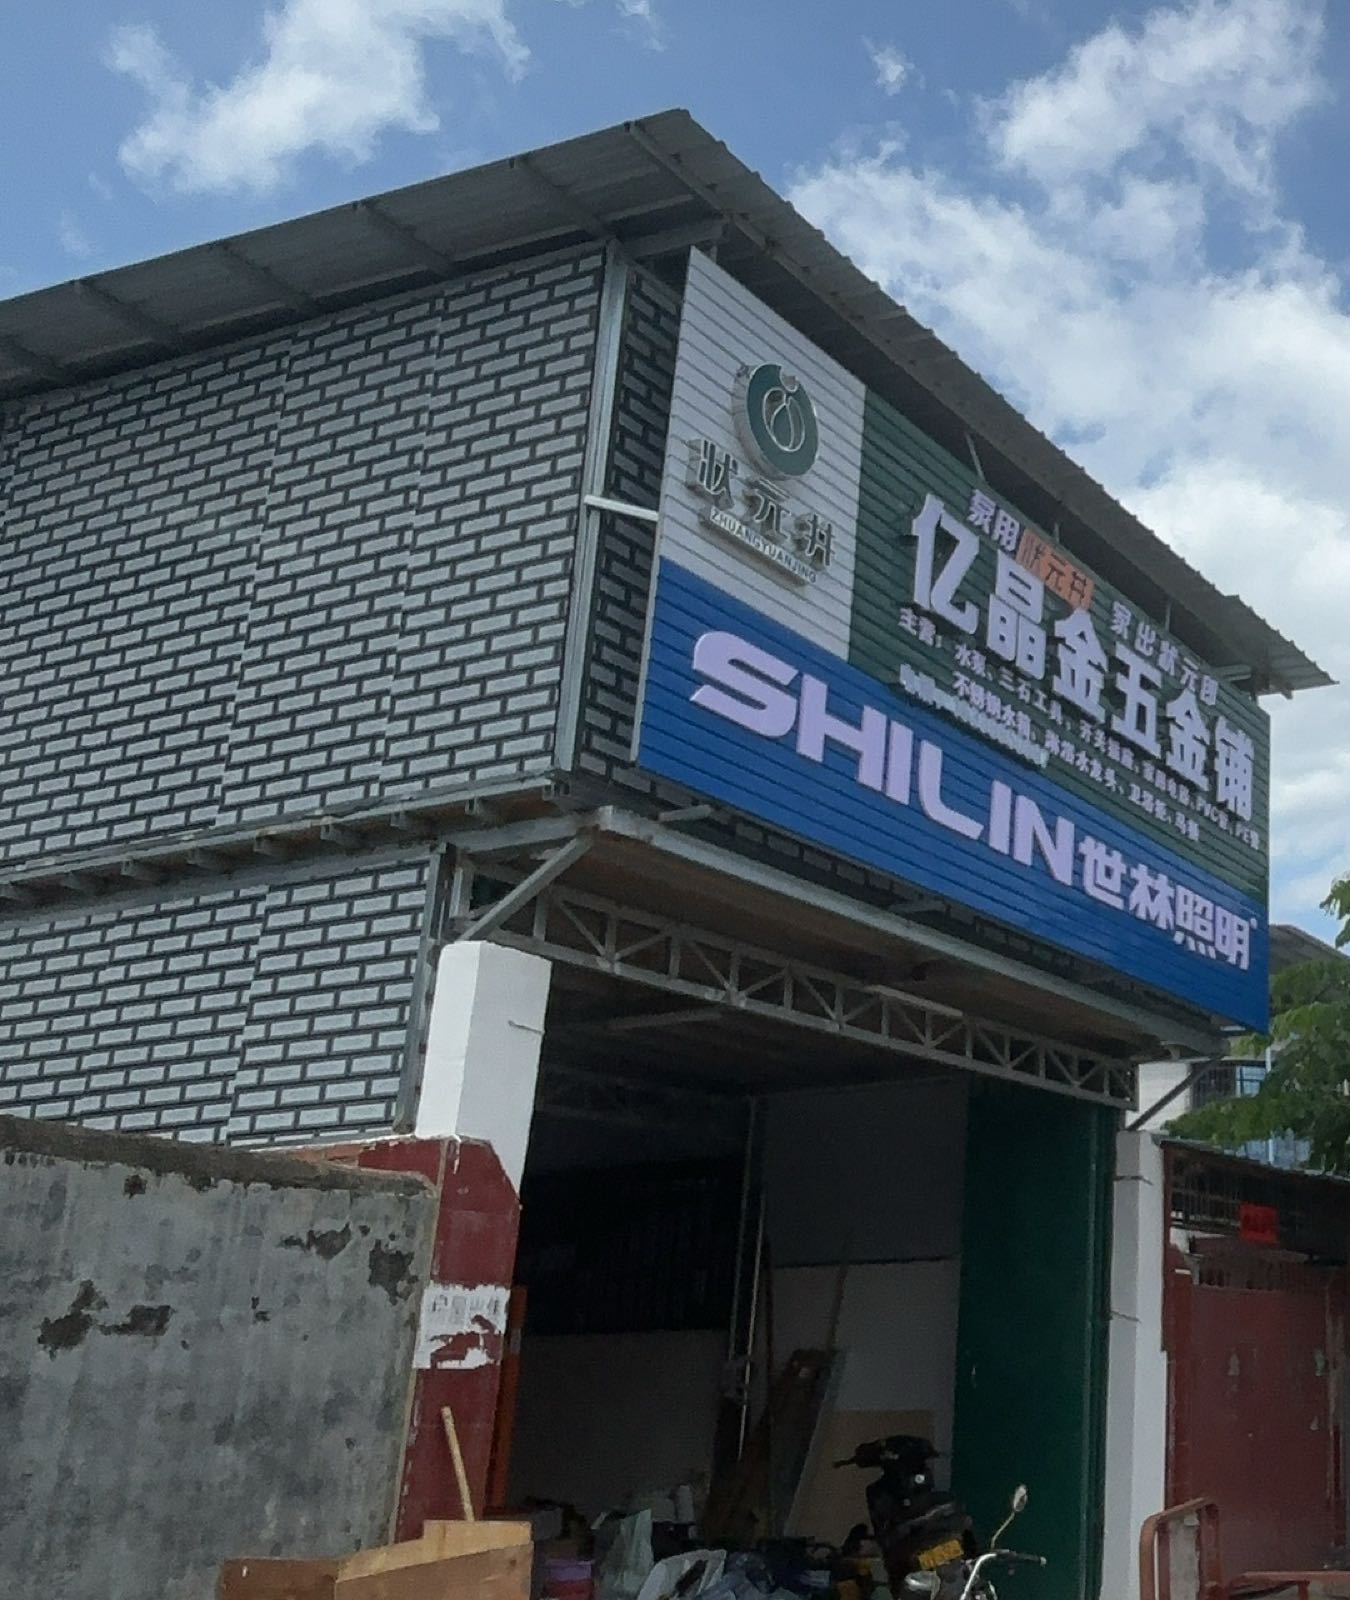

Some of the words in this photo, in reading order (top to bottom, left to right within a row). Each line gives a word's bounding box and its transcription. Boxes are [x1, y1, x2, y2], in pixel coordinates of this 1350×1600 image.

[709, 507, 818, 585] ZHUANGYUANJING
[911, 493, 1255, 821] 亿晶金五金铺
[689, 630, 1076, 887] SHILIN
[1076, 835, 1251, 971] 世林照明
